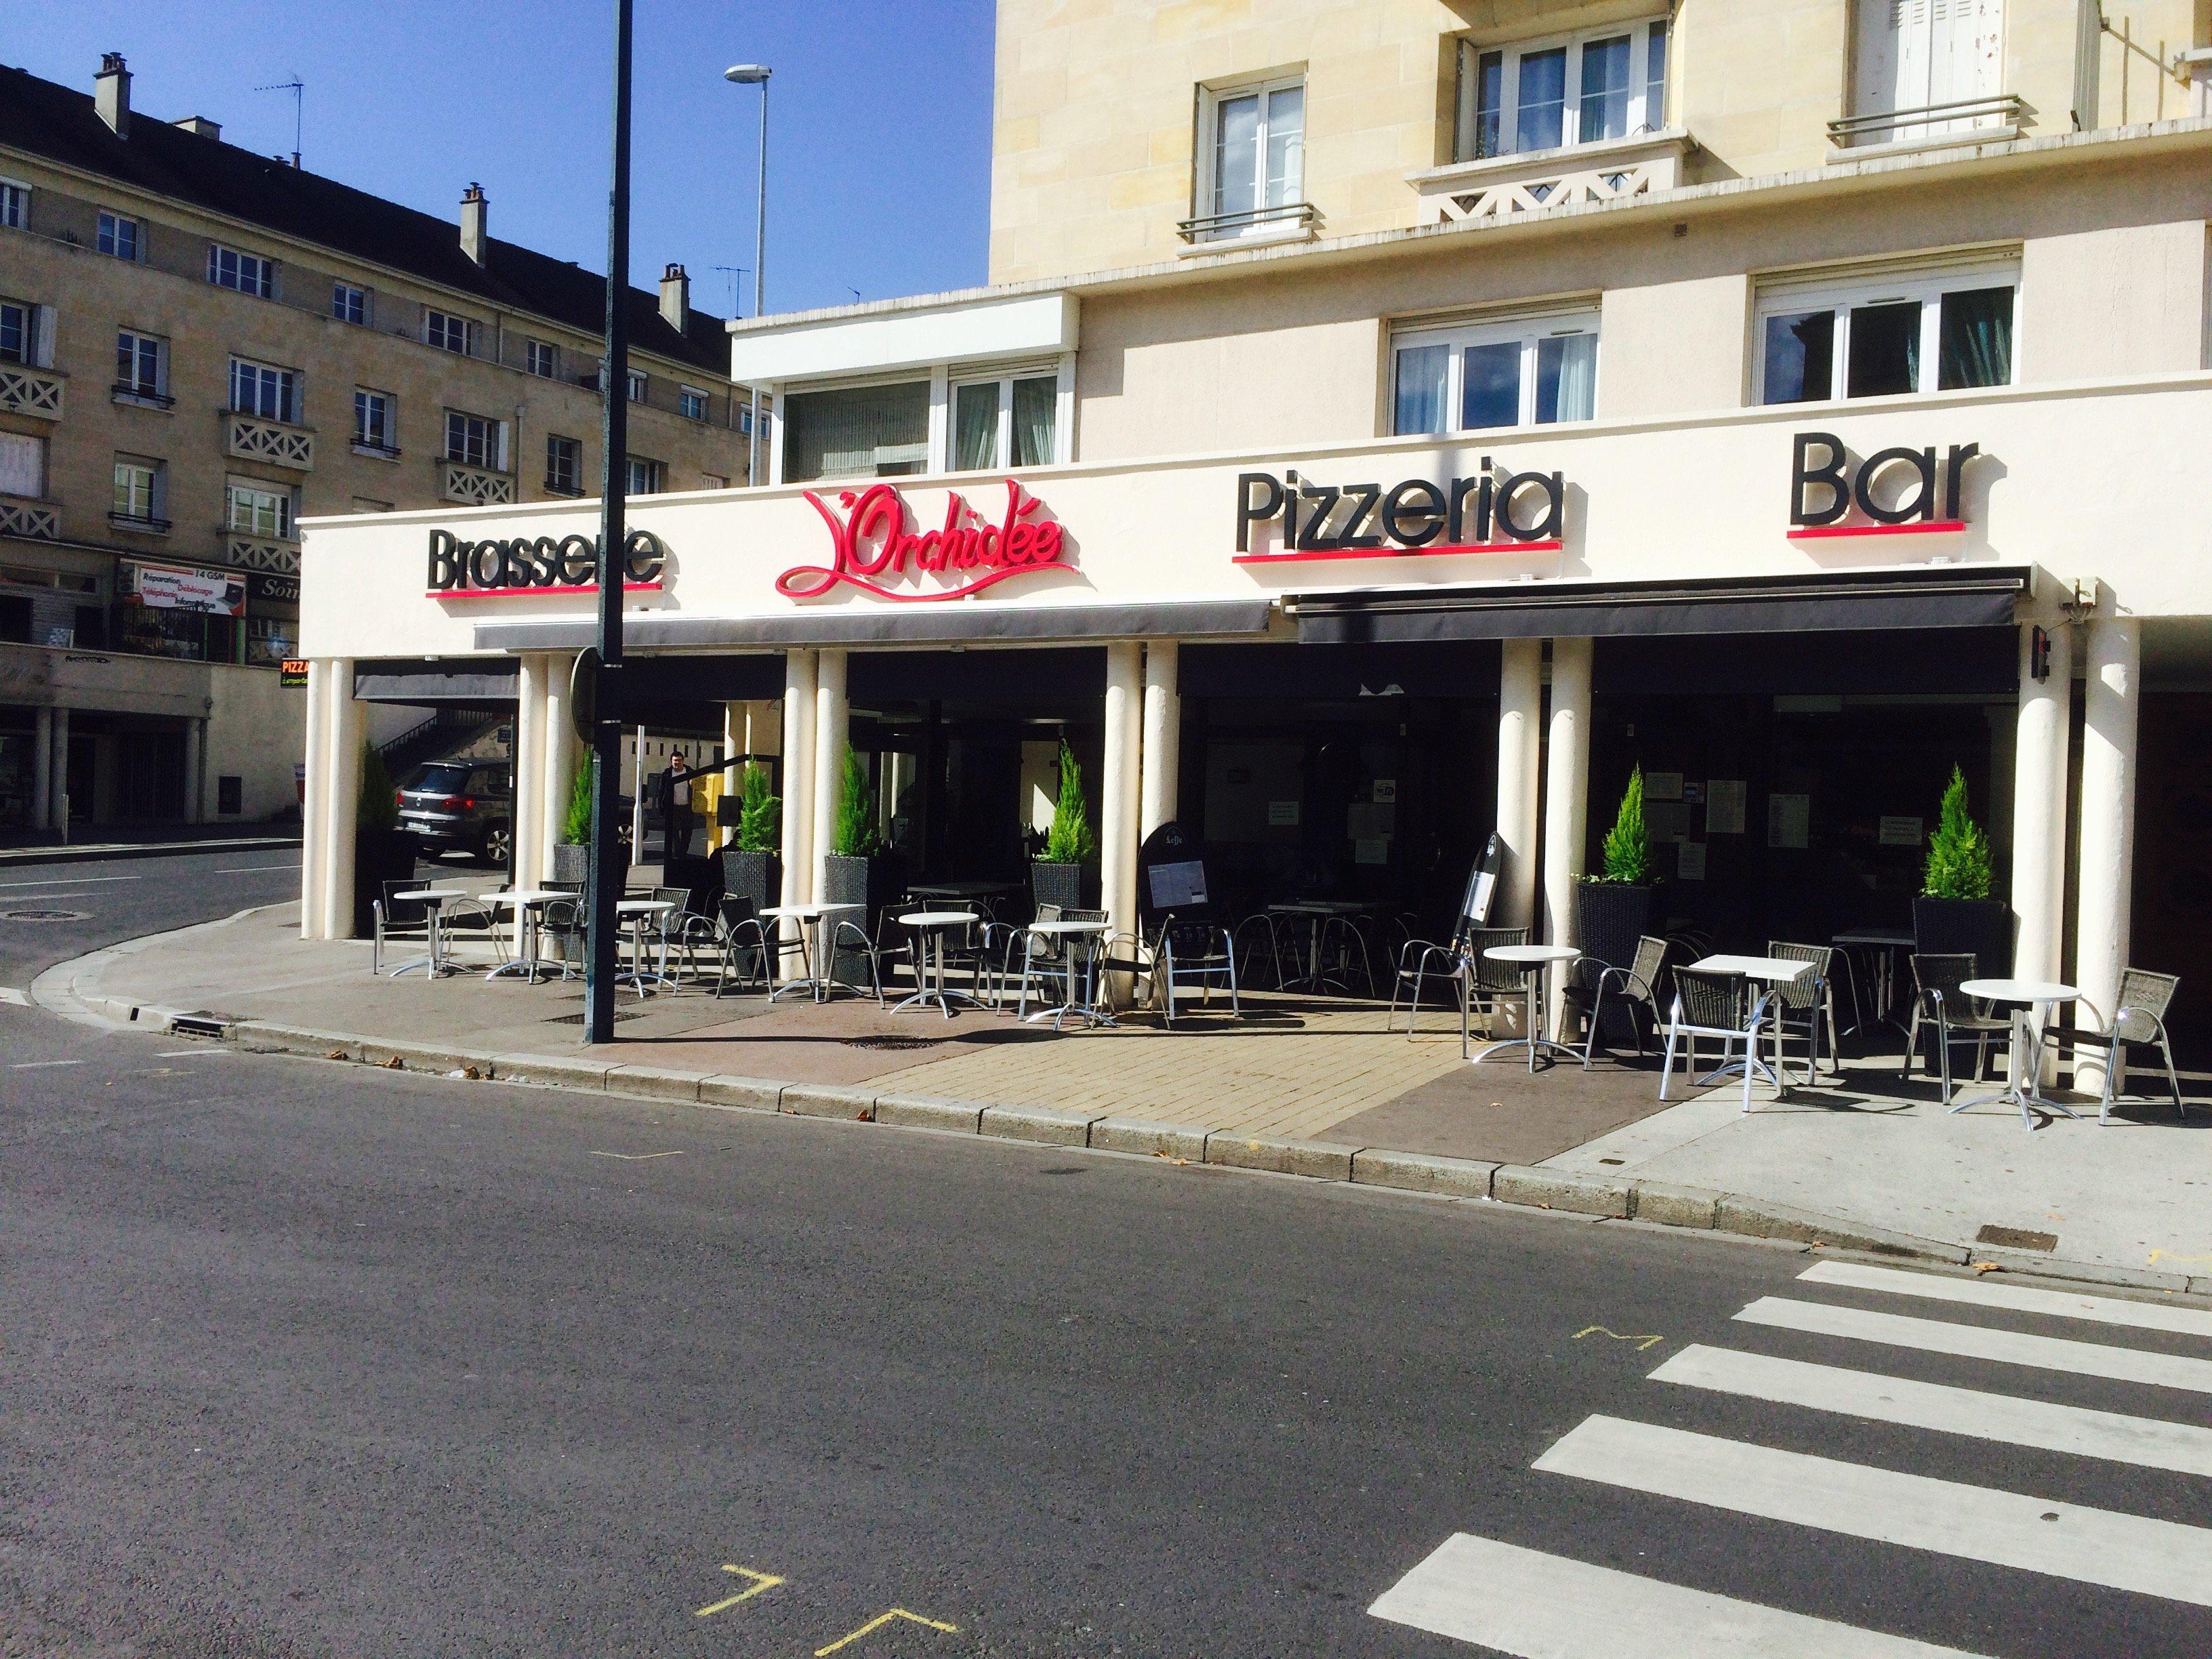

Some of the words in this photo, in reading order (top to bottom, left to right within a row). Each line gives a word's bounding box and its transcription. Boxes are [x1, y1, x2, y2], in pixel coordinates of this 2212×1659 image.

[1235, 456, 1564, 552] Pizzeria
[1790, 432, 1980, 527] Bar
[207, 571, 225, 581] GSM
[427, 529, 664, 589] Brassee
